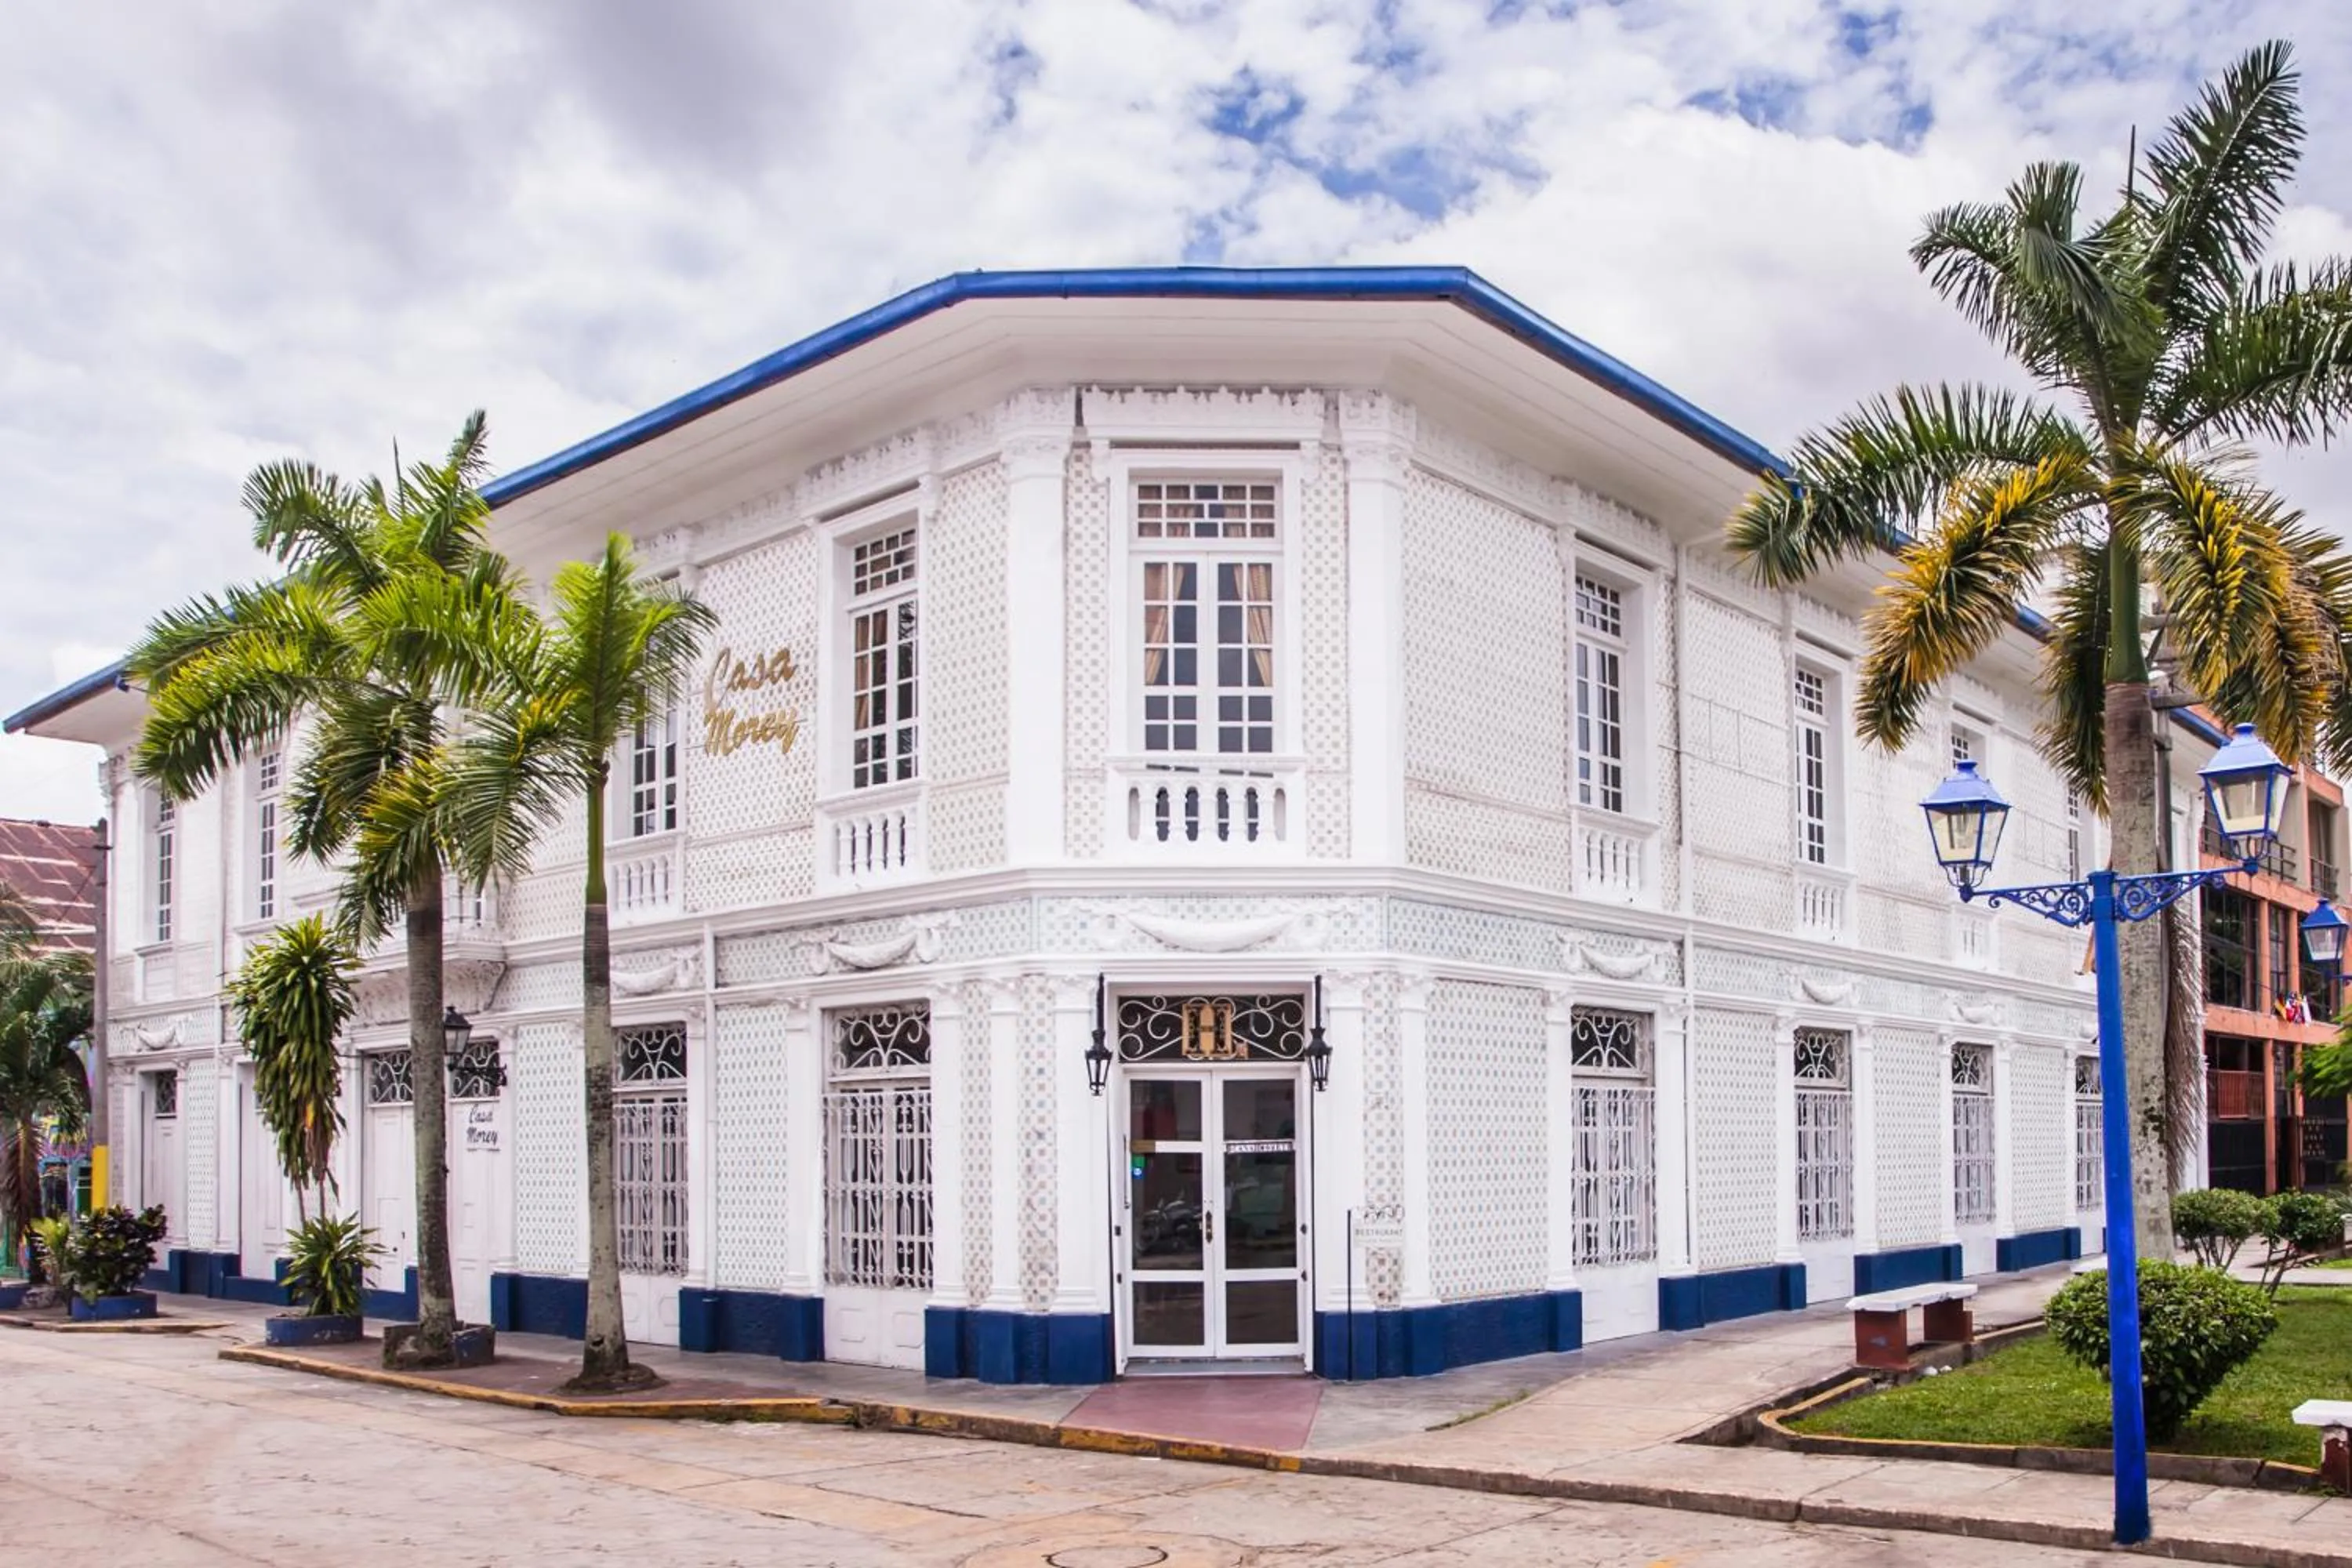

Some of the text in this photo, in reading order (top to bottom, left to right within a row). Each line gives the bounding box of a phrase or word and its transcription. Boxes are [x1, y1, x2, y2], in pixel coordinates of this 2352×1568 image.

[704, 647, 798, 710] Casa
[704, 706, 800, 757] Morey
[469, 1104, 493, 1123] Casa
[466, 1127, 498, 1145] Morey
